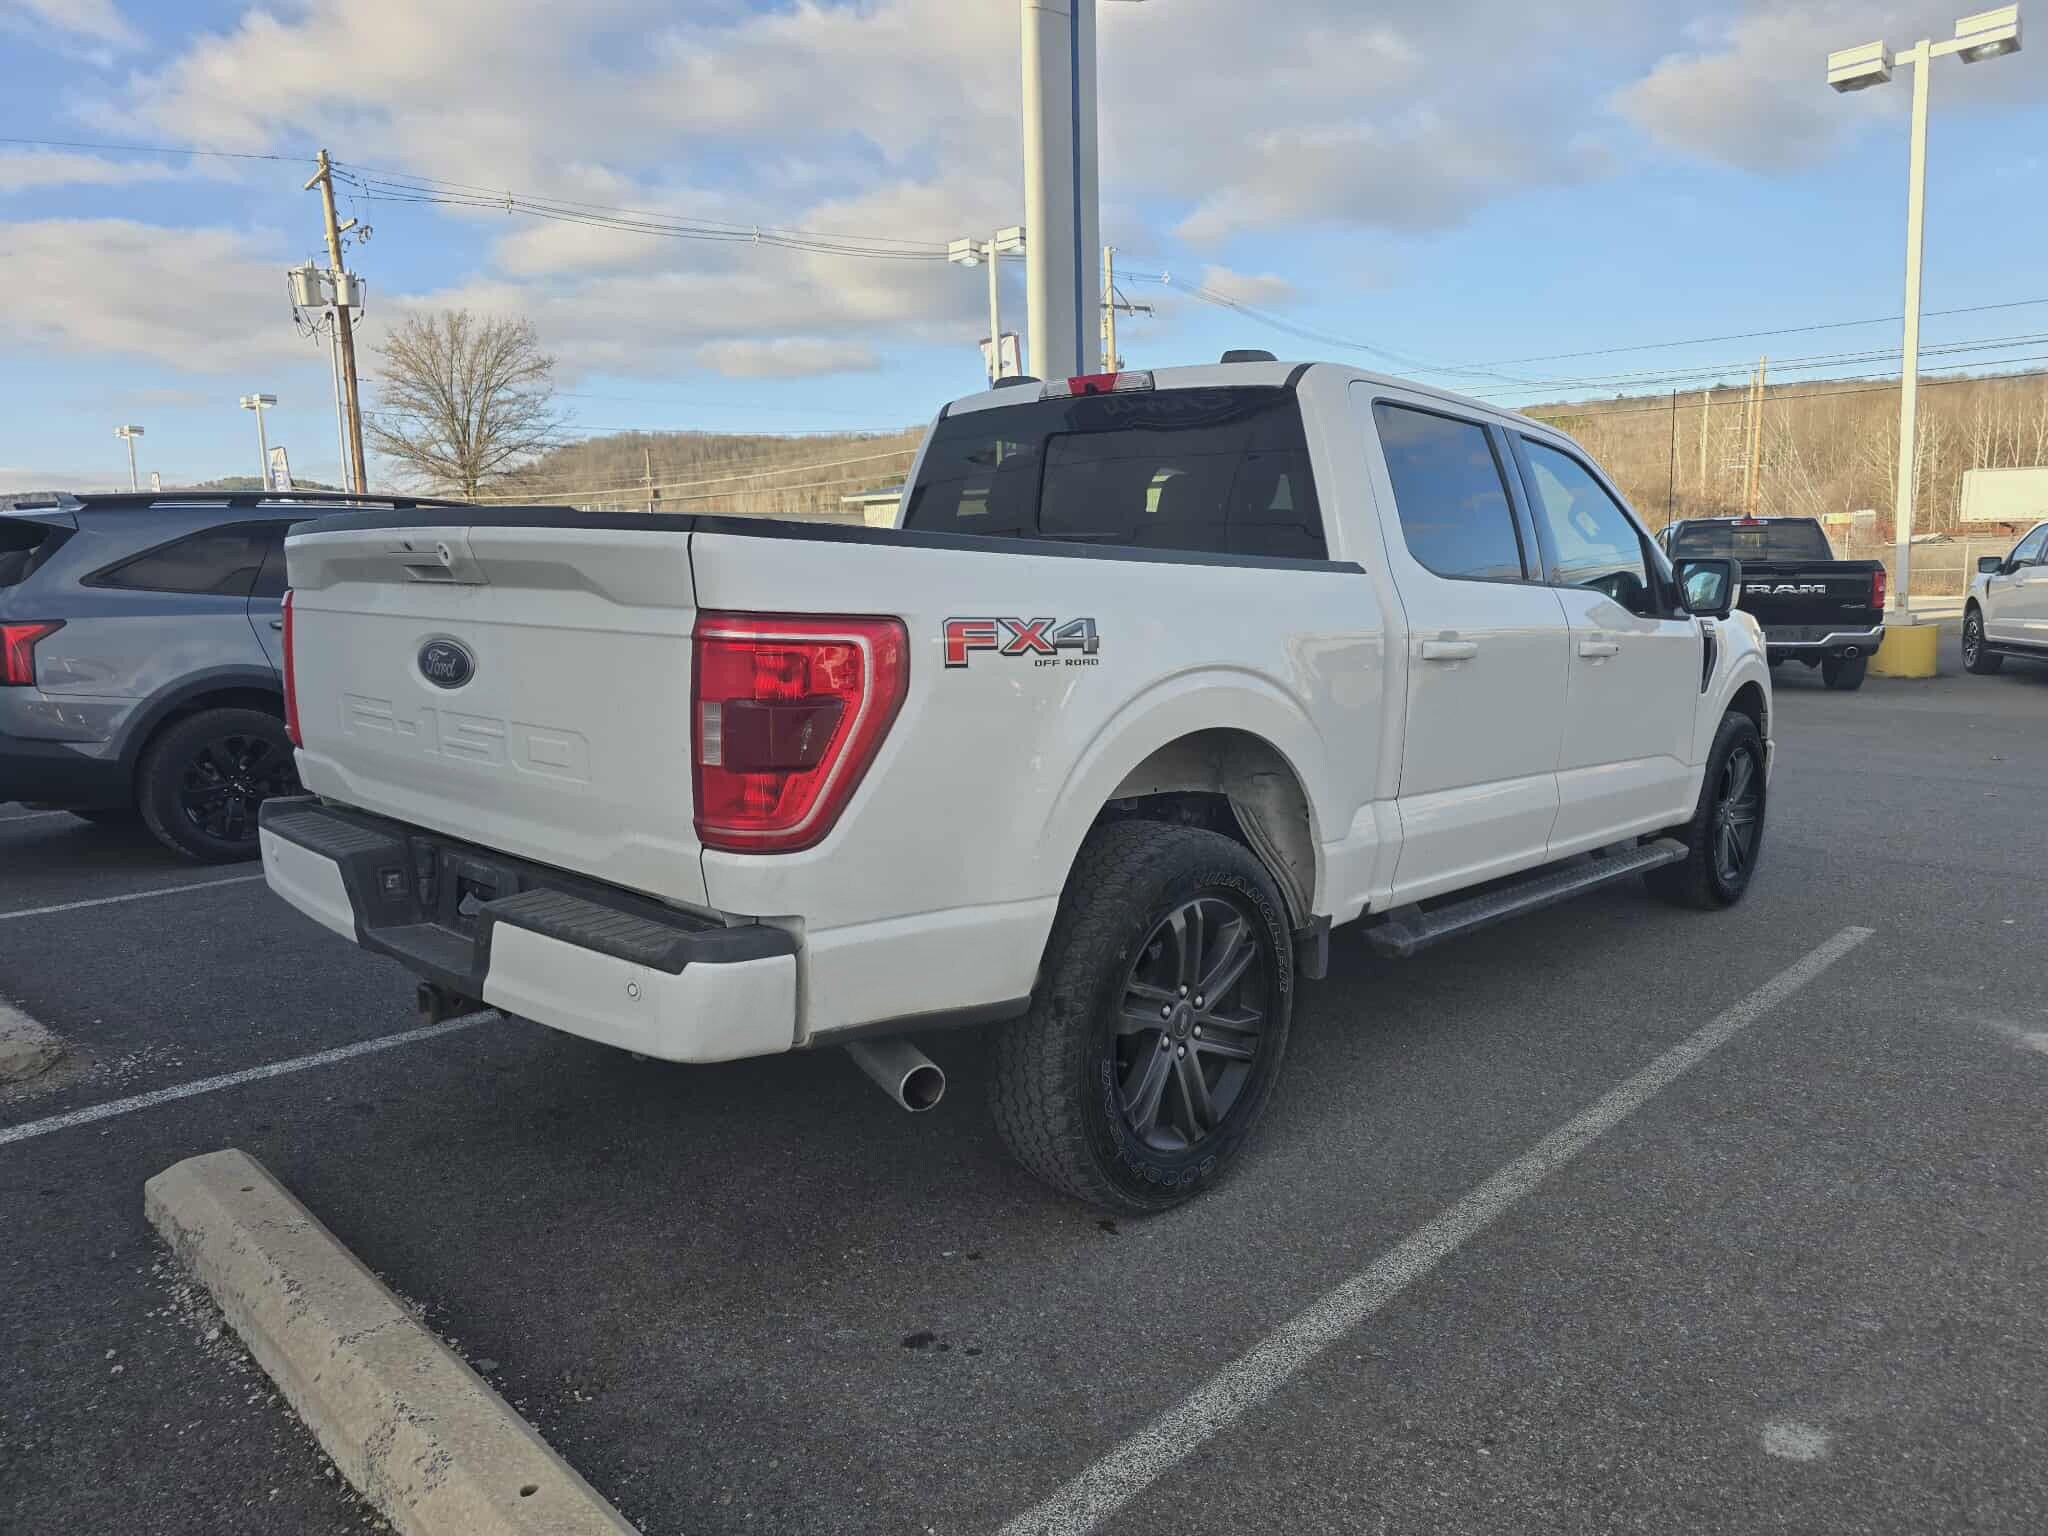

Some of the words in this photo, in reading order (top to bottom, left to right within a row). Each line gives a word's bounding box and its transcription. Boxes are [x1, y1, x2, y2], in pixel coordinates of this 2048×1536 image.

[1746, 584, 1826, 594] RAM
[943, 617, 1100, 668] FX4
[425, 649, 457, 678] Ford
[1034, 659, 1061, 667] OFF
[1065, 658, 1099, 667] ROAD
[1199, 871, 1290, 994] WRANGLER
